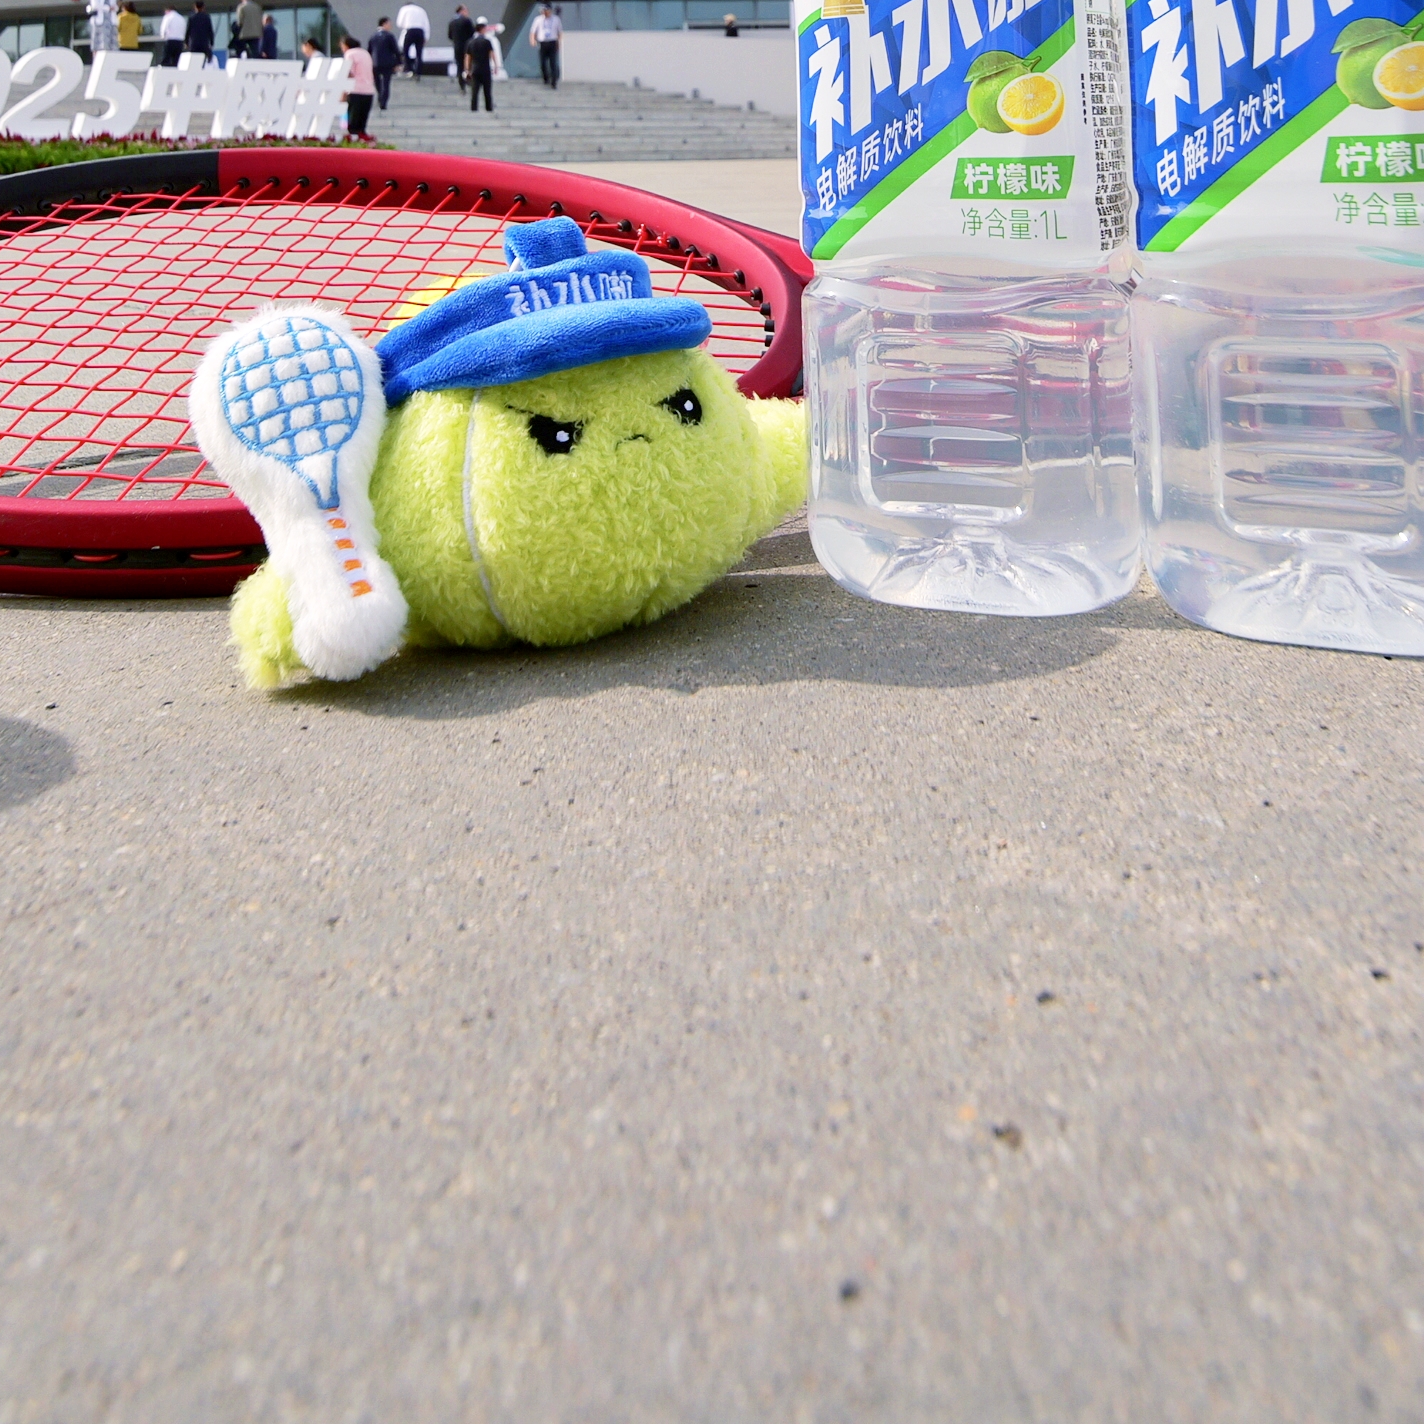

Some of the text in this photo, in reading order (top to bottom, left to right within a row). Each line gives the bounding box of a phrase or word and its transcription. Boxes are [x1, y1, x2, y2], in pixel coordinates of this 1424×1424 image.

[816, 103, 924, 212] 电解质饮料
[1156, 76, 1286, 198] 电解质饮料
[962, 161, 1062, 195] 柠檬味
[505, 270, 633, 317] 补水啦
